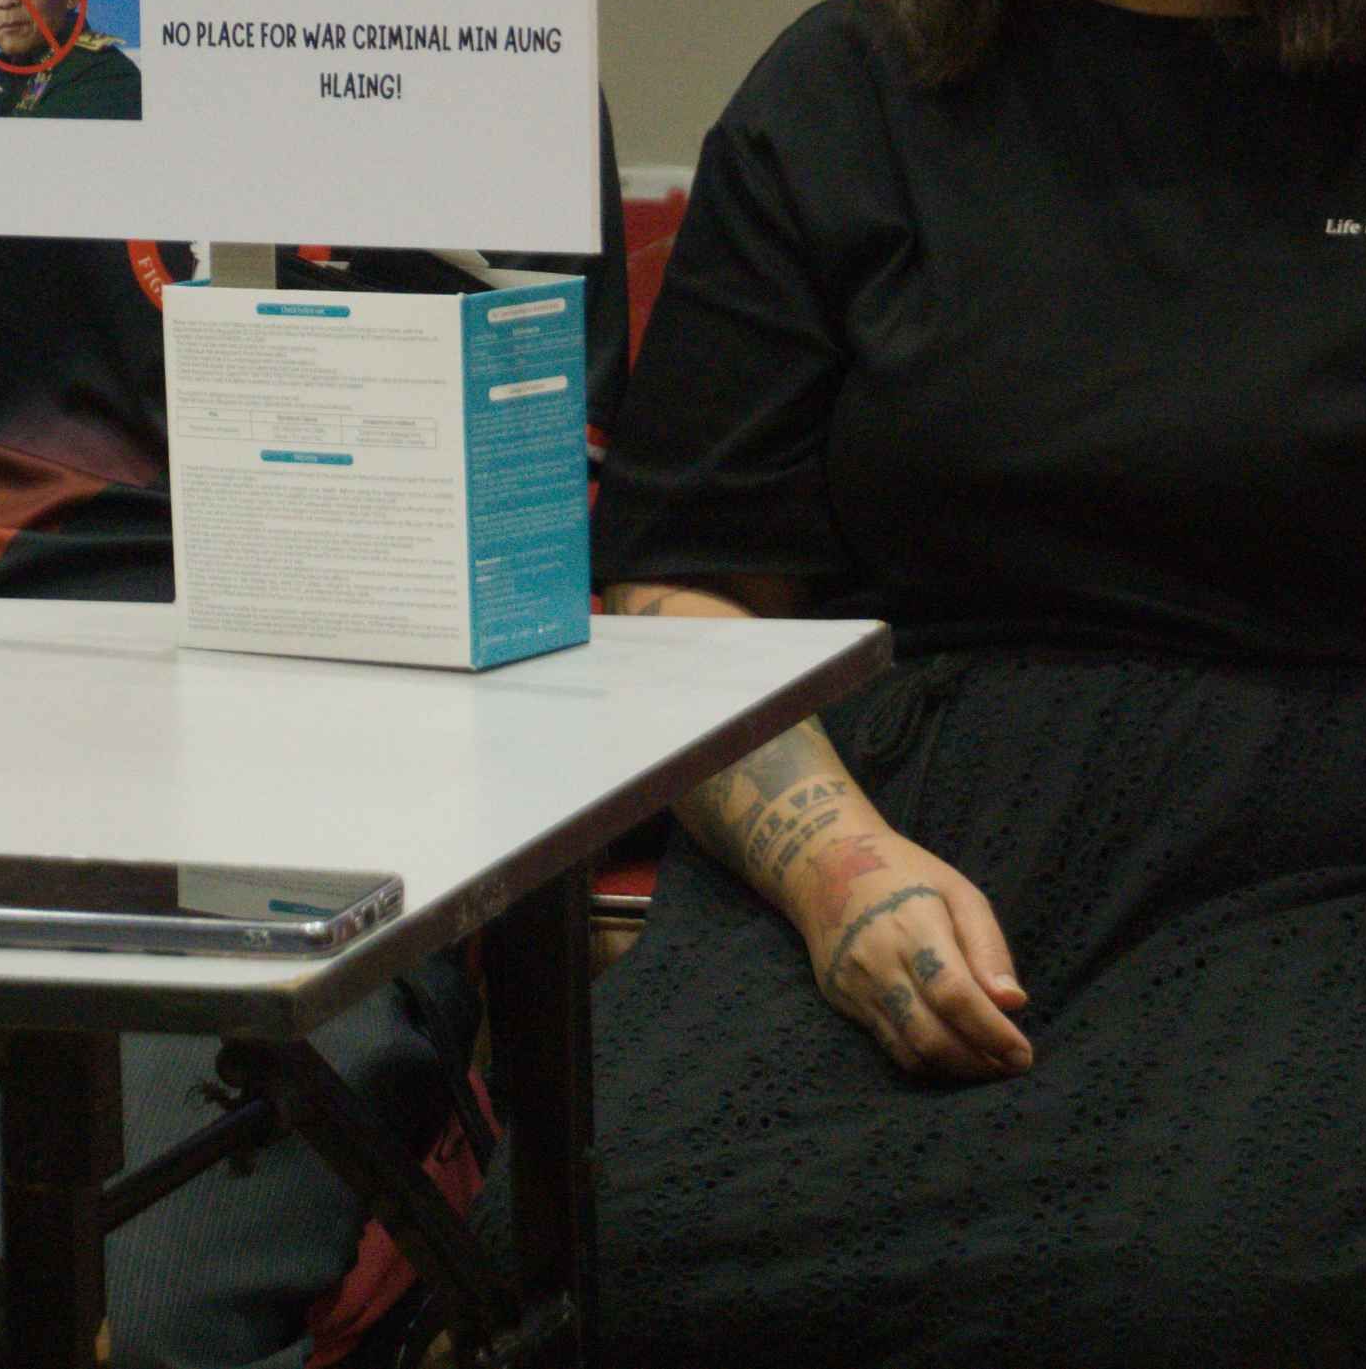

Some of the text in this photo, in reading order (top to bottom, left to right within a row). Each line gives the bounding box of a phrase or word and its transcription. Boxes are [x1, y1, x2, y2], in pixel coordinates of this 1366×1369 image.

[163, 22, 561, 53] NO PLACE FOR WAR CRIMINAL MIN AUNG
[320, 73, 401, 99] HLAING!
[1325, 218, 1362, 235] Life
